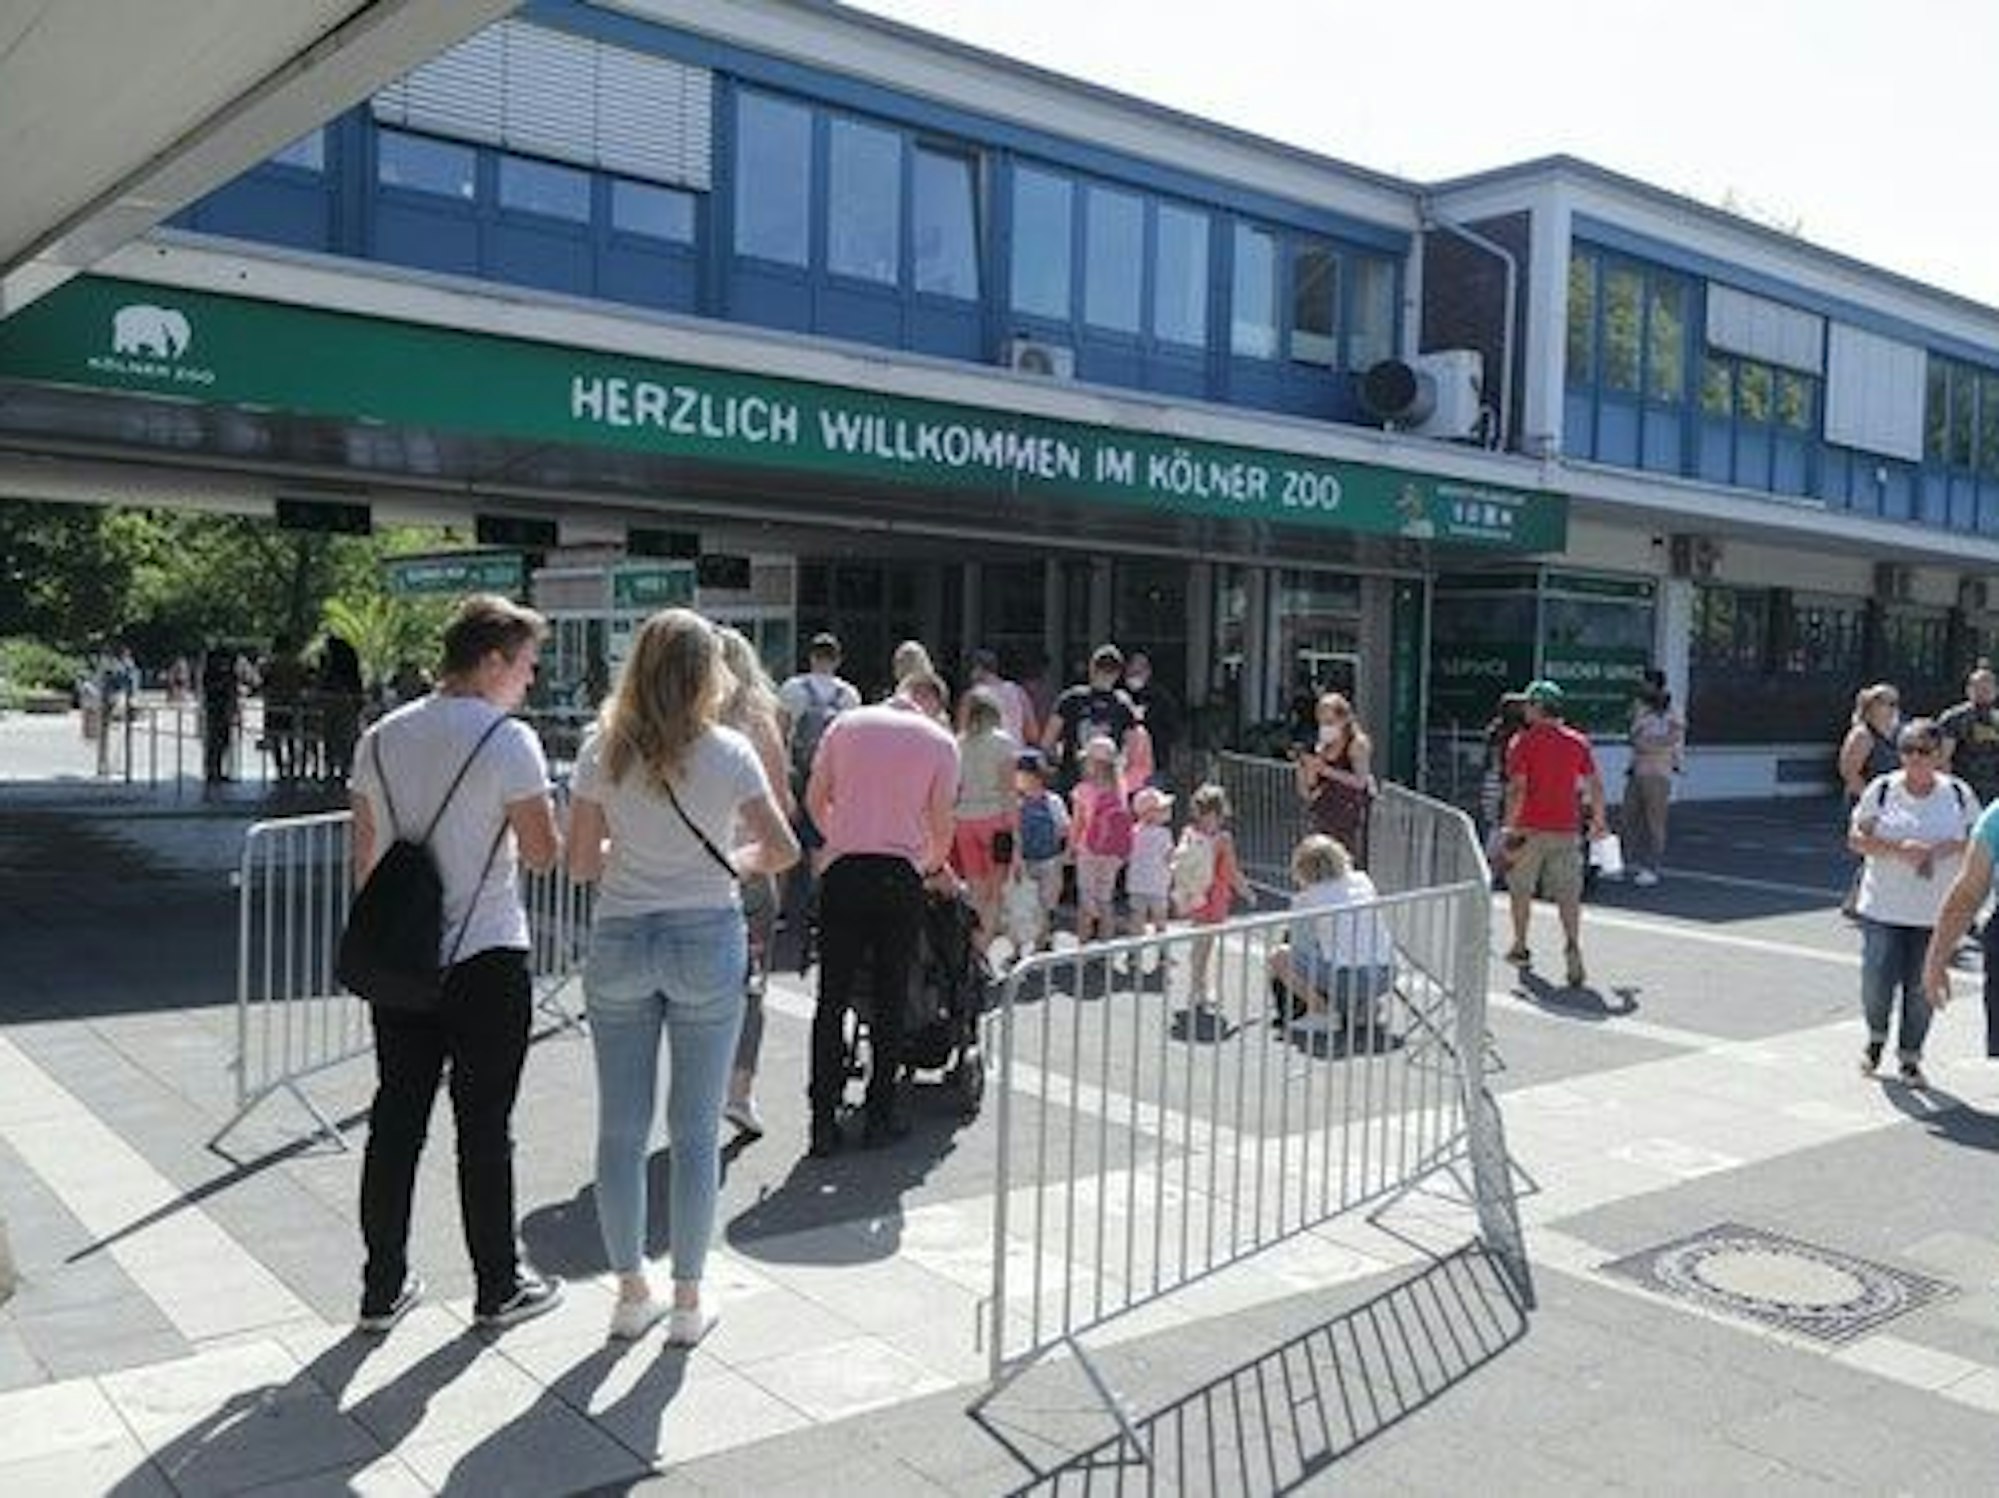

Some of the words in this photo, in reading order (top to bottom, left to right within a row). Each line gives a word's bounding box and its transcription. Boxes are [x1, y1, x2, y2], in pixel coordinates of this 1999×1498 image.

[571, 376, 797, 443] HERZLICH
[820, 409, 1080, 480] WILLKOMMEN
[1096, 448, 1134, 486] IM
[1149, 446, 1269, 502] KÖLNER
[1281, 471, 1341, 511] ZOO
